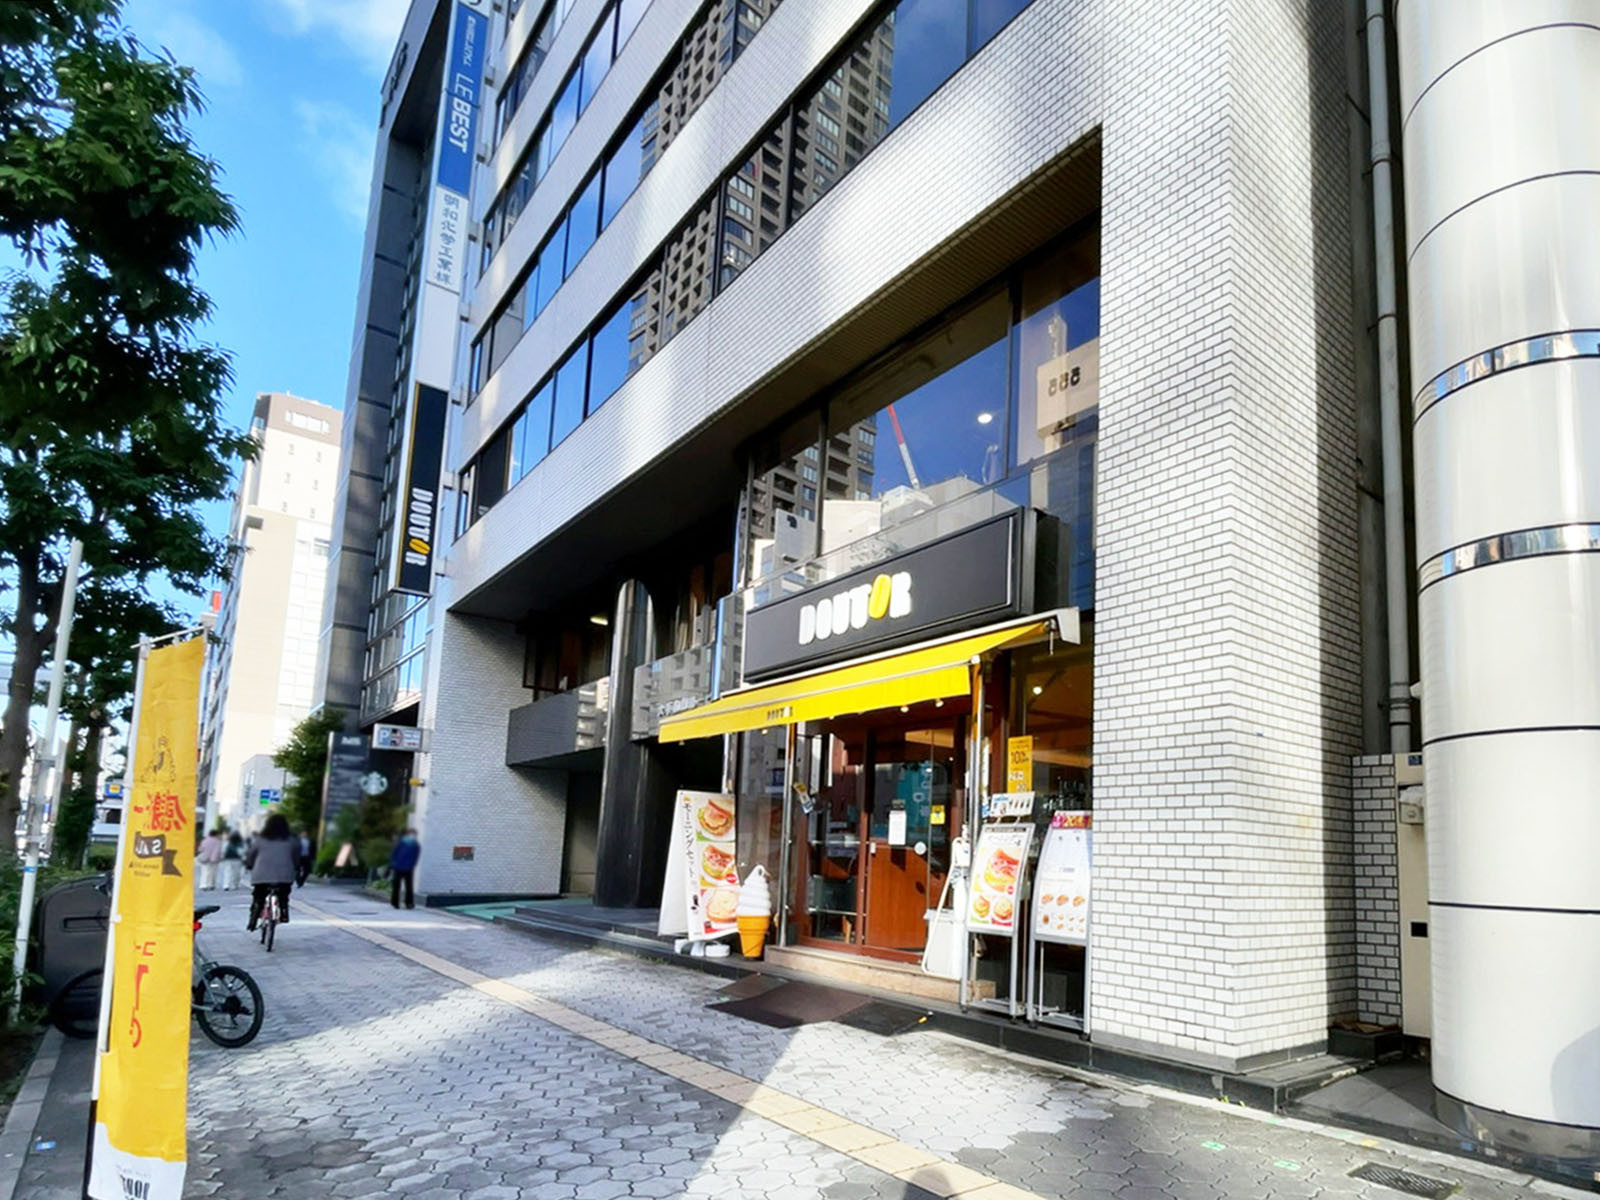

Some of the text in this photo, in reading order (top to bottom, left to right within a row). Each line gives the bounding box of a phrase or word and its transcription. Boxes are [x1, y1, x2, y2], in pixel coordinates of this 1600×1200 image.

[453, 73, 474, 101] LE
[449, 97, 473, 153] BEST
[405, 487, 434, 566] DOUTOR
[799, 571, 912, 645] DOUTOR
